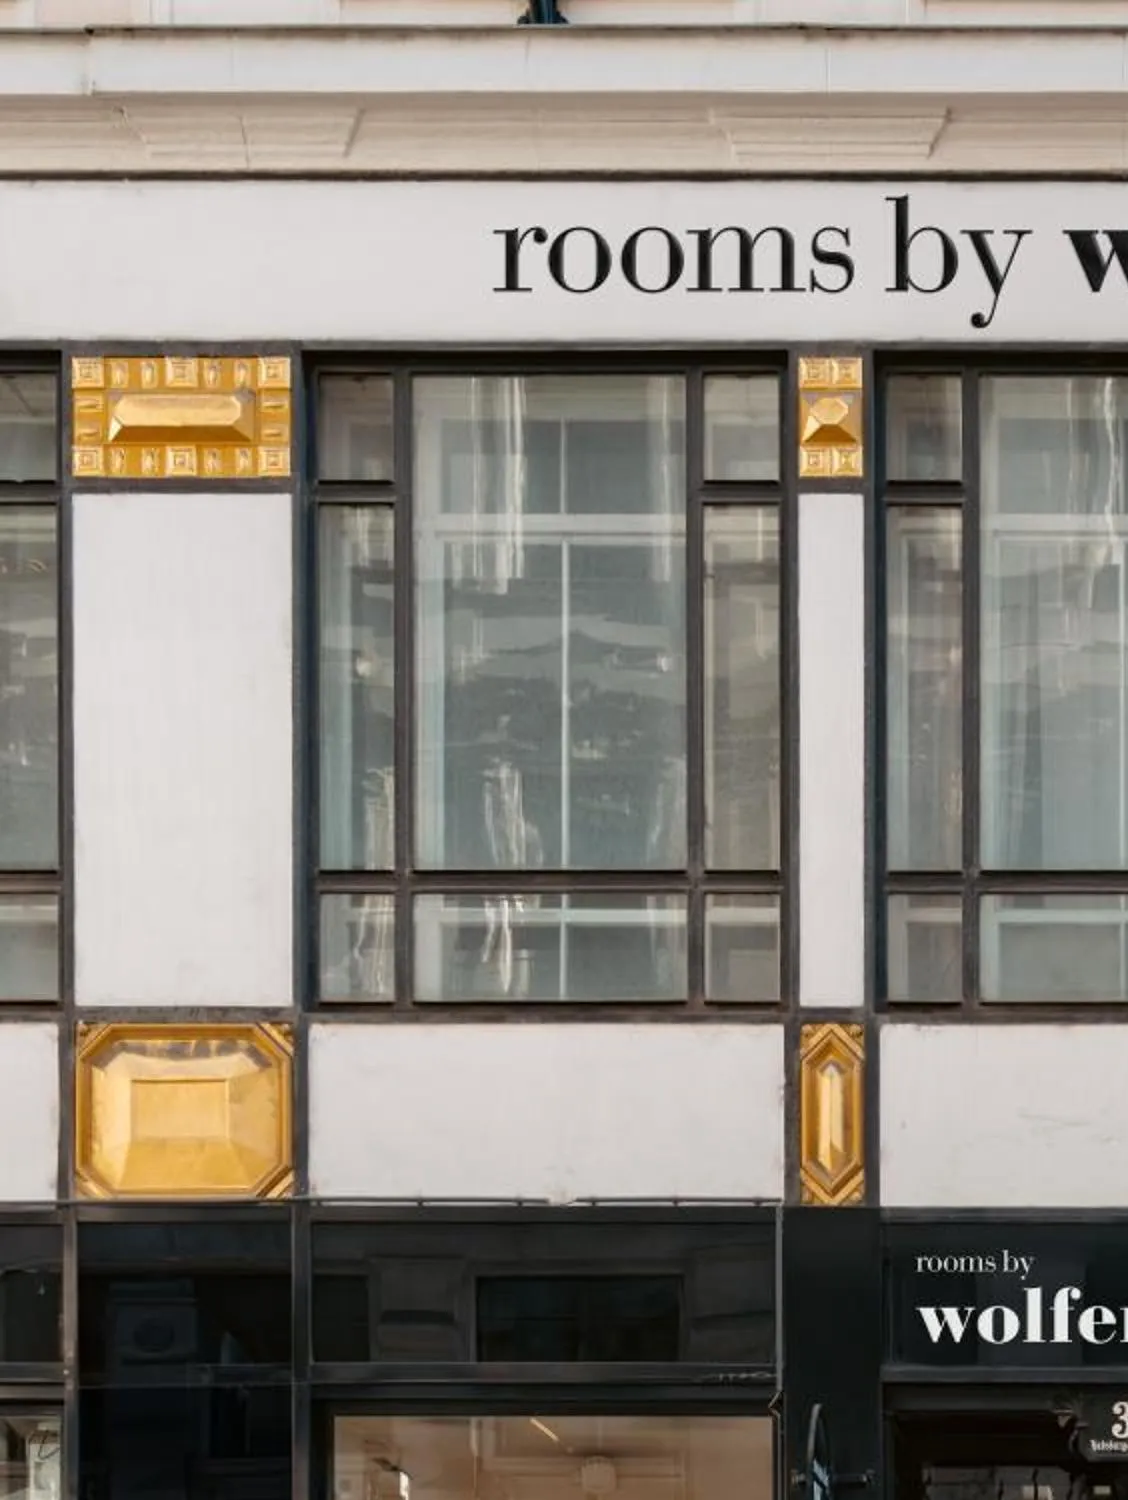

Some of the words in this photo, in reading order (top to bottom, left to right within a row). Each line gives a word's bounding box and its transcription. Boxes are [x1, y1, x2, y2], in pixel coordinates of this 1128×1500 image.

[492, 226, 855, 294] rooms
[885, 194, 1034, 329] by
[915, 1254, 997, 1273] rooms
[1002, 1249, 1035, 1280] by
